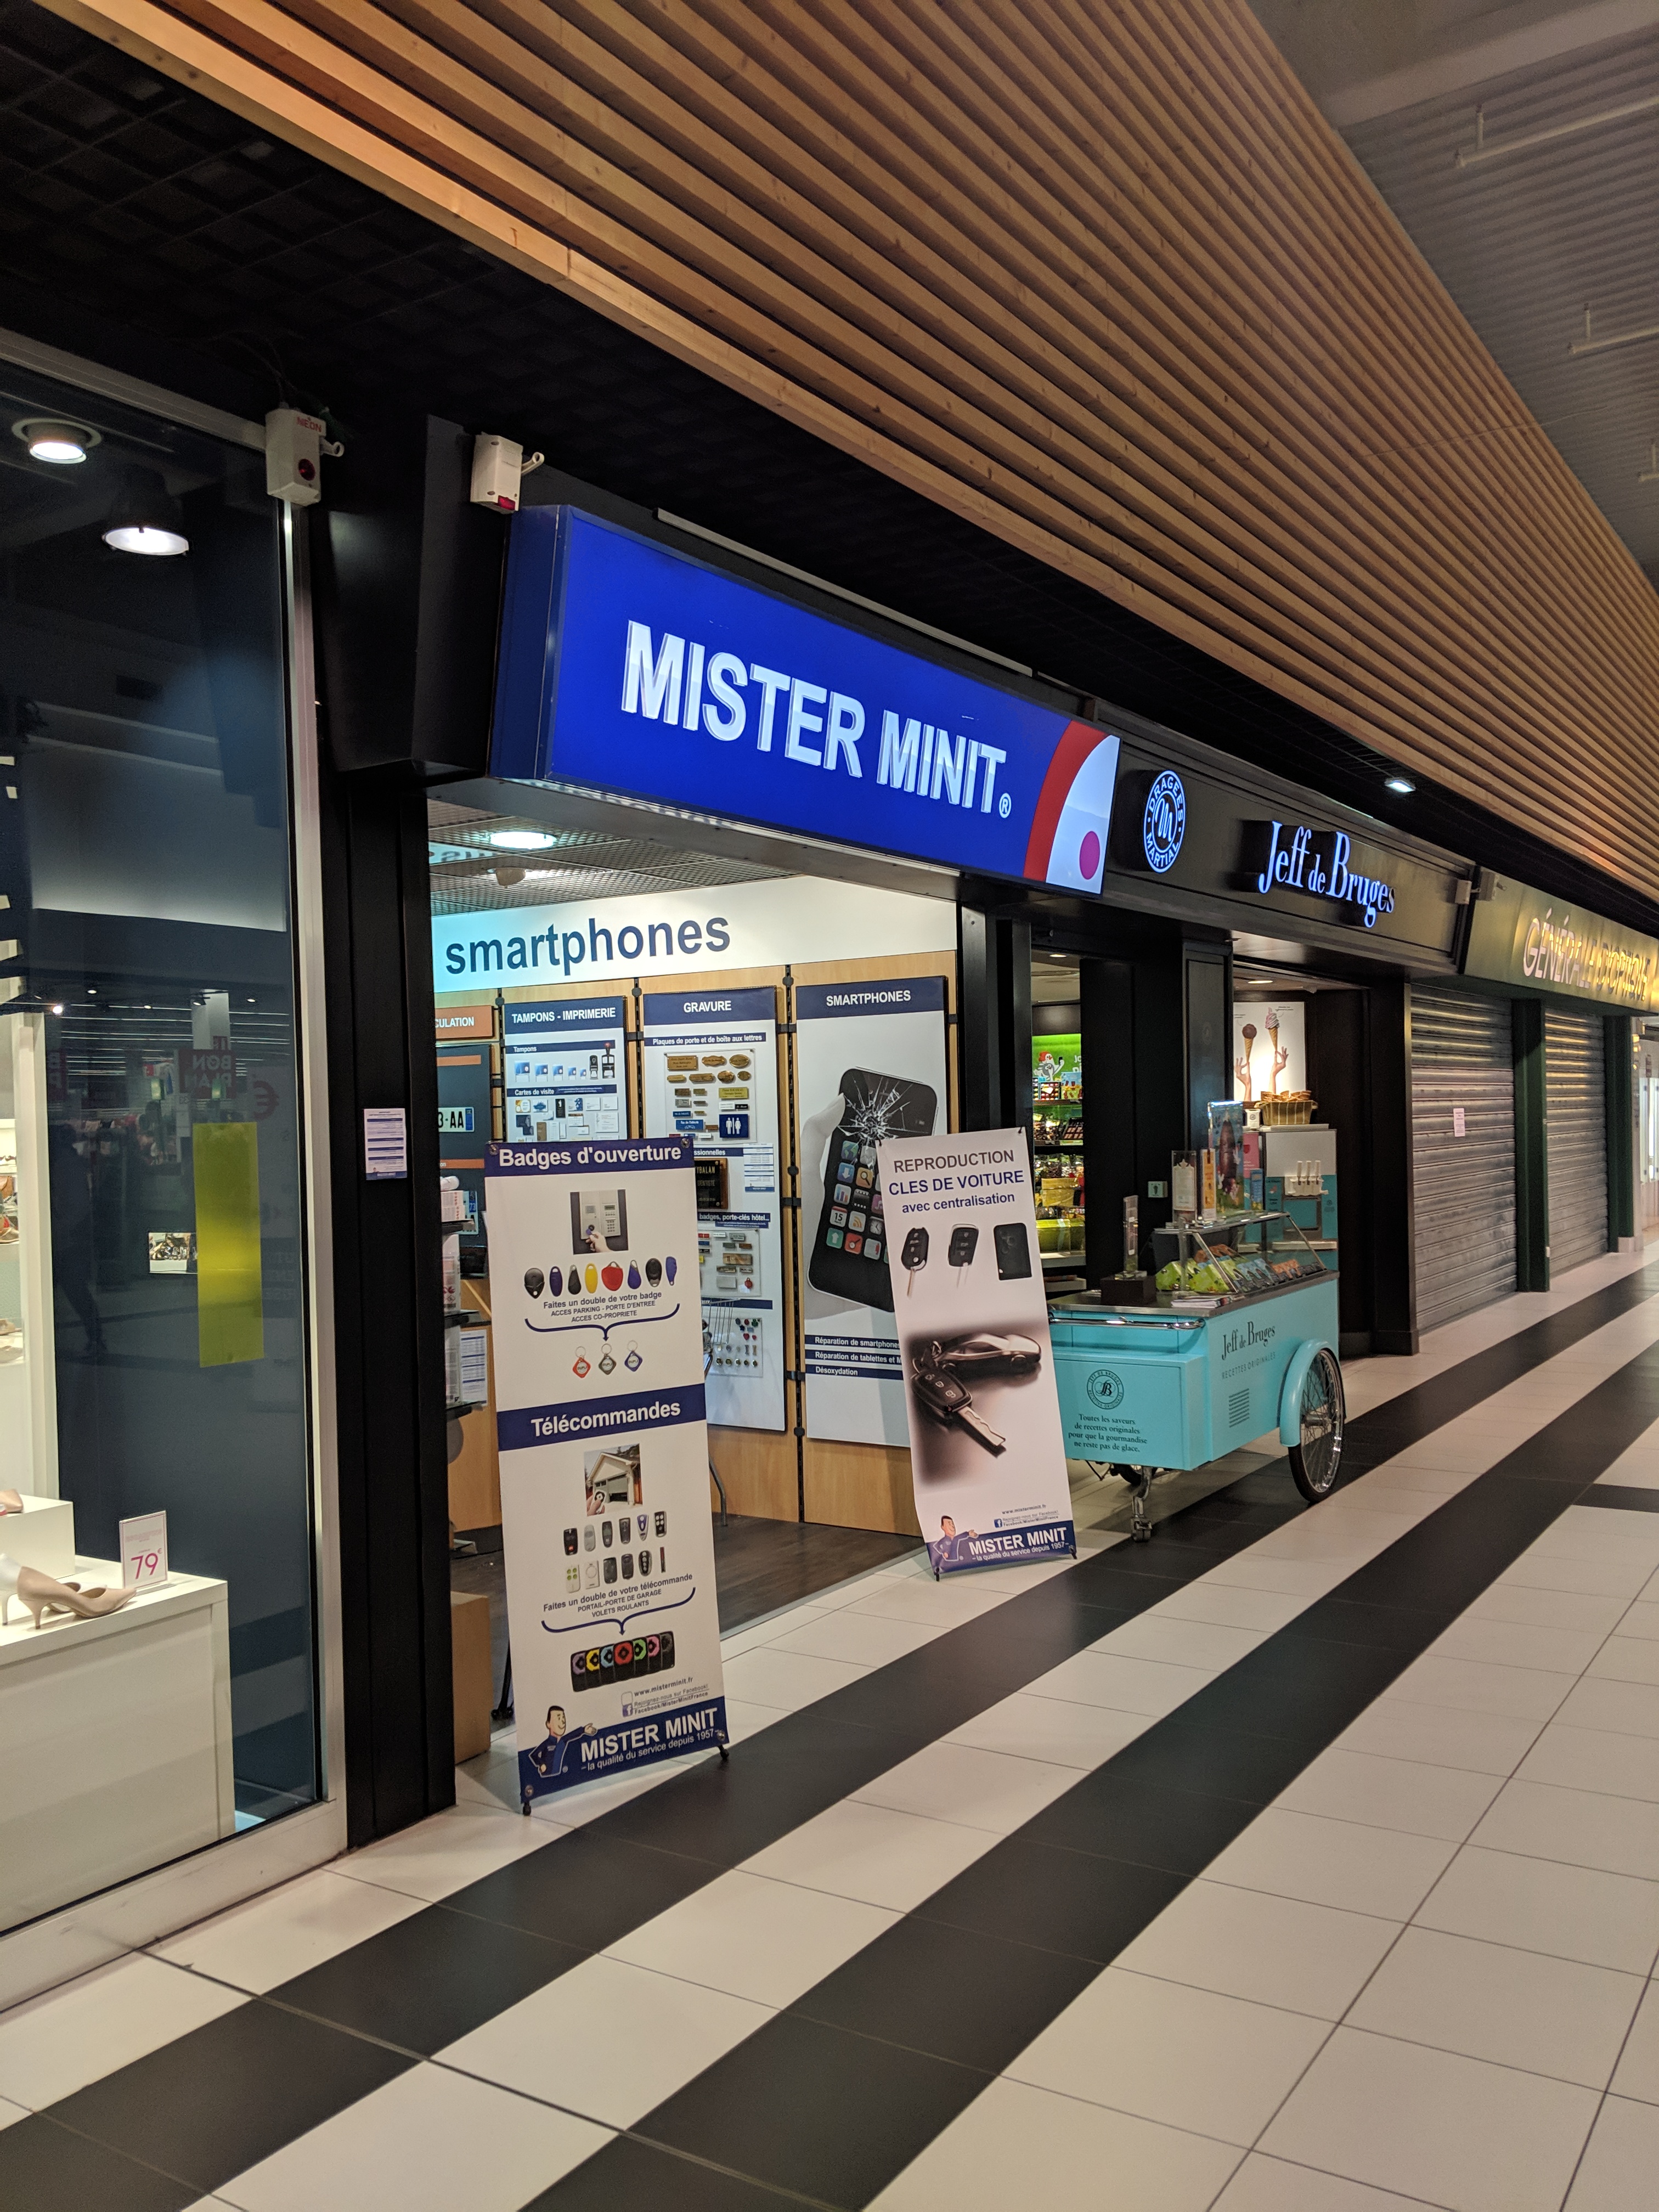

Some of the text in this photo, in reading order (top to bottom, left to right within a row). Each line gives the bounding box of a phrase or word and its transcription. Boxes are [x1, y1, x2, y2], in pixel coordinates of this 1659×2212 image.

[296, 416, 322, 432] NEON
[621, 619, 865, 778] MISTER
[1146, 832, 1179, 867] MARTIAL
[1258, 821, 1395, 928] Jeff de Bruges
[445, 917, 730, 975] smartphones
[684, 1000, 732, 1013] GRAVURE
[826, 990, 911, 1006] SMARTPHONES
[512, 1012, 555, 1024] TAMPONS
[562, 1007, 616, 1021] IMPRIMERIE
[653, 1038, 675, 1046] Plaques
[499, 1145, 682, 1170] Badges d'ouverture
[894, 1149, 1014, 1173] REPRODUCTION
[889, 1170, 1025, 1195] CLES DE VOITURE
[902, 1193, 1015, 1214] avec centralisation
[835, 1212, 843, 1221] 15
[544, 1300, 567, 1310] Faites
[580, 1296, 606, 1305] double
[640, 1291, 662, 1301] badge
[573, 1306, 601, 1314] PARKING
[627, 1300, 656, 1309] D'ENTREE
[571, 1310, 637, 1323] ACCES CO-PROPRIETE
[815, 1336, 849, 1346] Réparation
[1221, 1321, 1276, 1361] Jeff de Bruges
[815, 1351, 849, 1361] Réparation
[860, 1354, 888, 1363] tablettes
[815, 1366, 858, 1376] Désoxydation
[531, 1401, 681, 1437] Télécommandes
[1079, 1413, 1100, 1422] Toutes
[1109, 1425, 1141, 1435] originales
[1105, 1436, 1148, 1444] gourmandise
[1121, 1444, 1141, 1452] glace.
[968, 1527, 1067, 1556] MISTER MINIT
[983, 1551, 1002, 1562] qualité
[1011, 1548, 1031, 1556] service
[1031, 1544, 1050, 1555] depuis
[543, 1573, 693, 1612] Faites un double de votre télécommande
[578, 1588, 662, 1613] PORTAIL-PORTE DE GARAGE
[591, 1600, 650, 1618] VOLETS ROULANTS
[634, 1677, 693, 1697] www.misterminit.fr
[580, 1707, 719, 1763] MISTER MINIT
[587, 1761, 595, 1771] la
[596, 1753, 624, 1770] qualité
[625, 1751, 636, 1760] du
[638, 1743, 666, 1757] service
[668, 1735, 695, 1752] depuis
[696, 1728, 714, 1741] 1957
